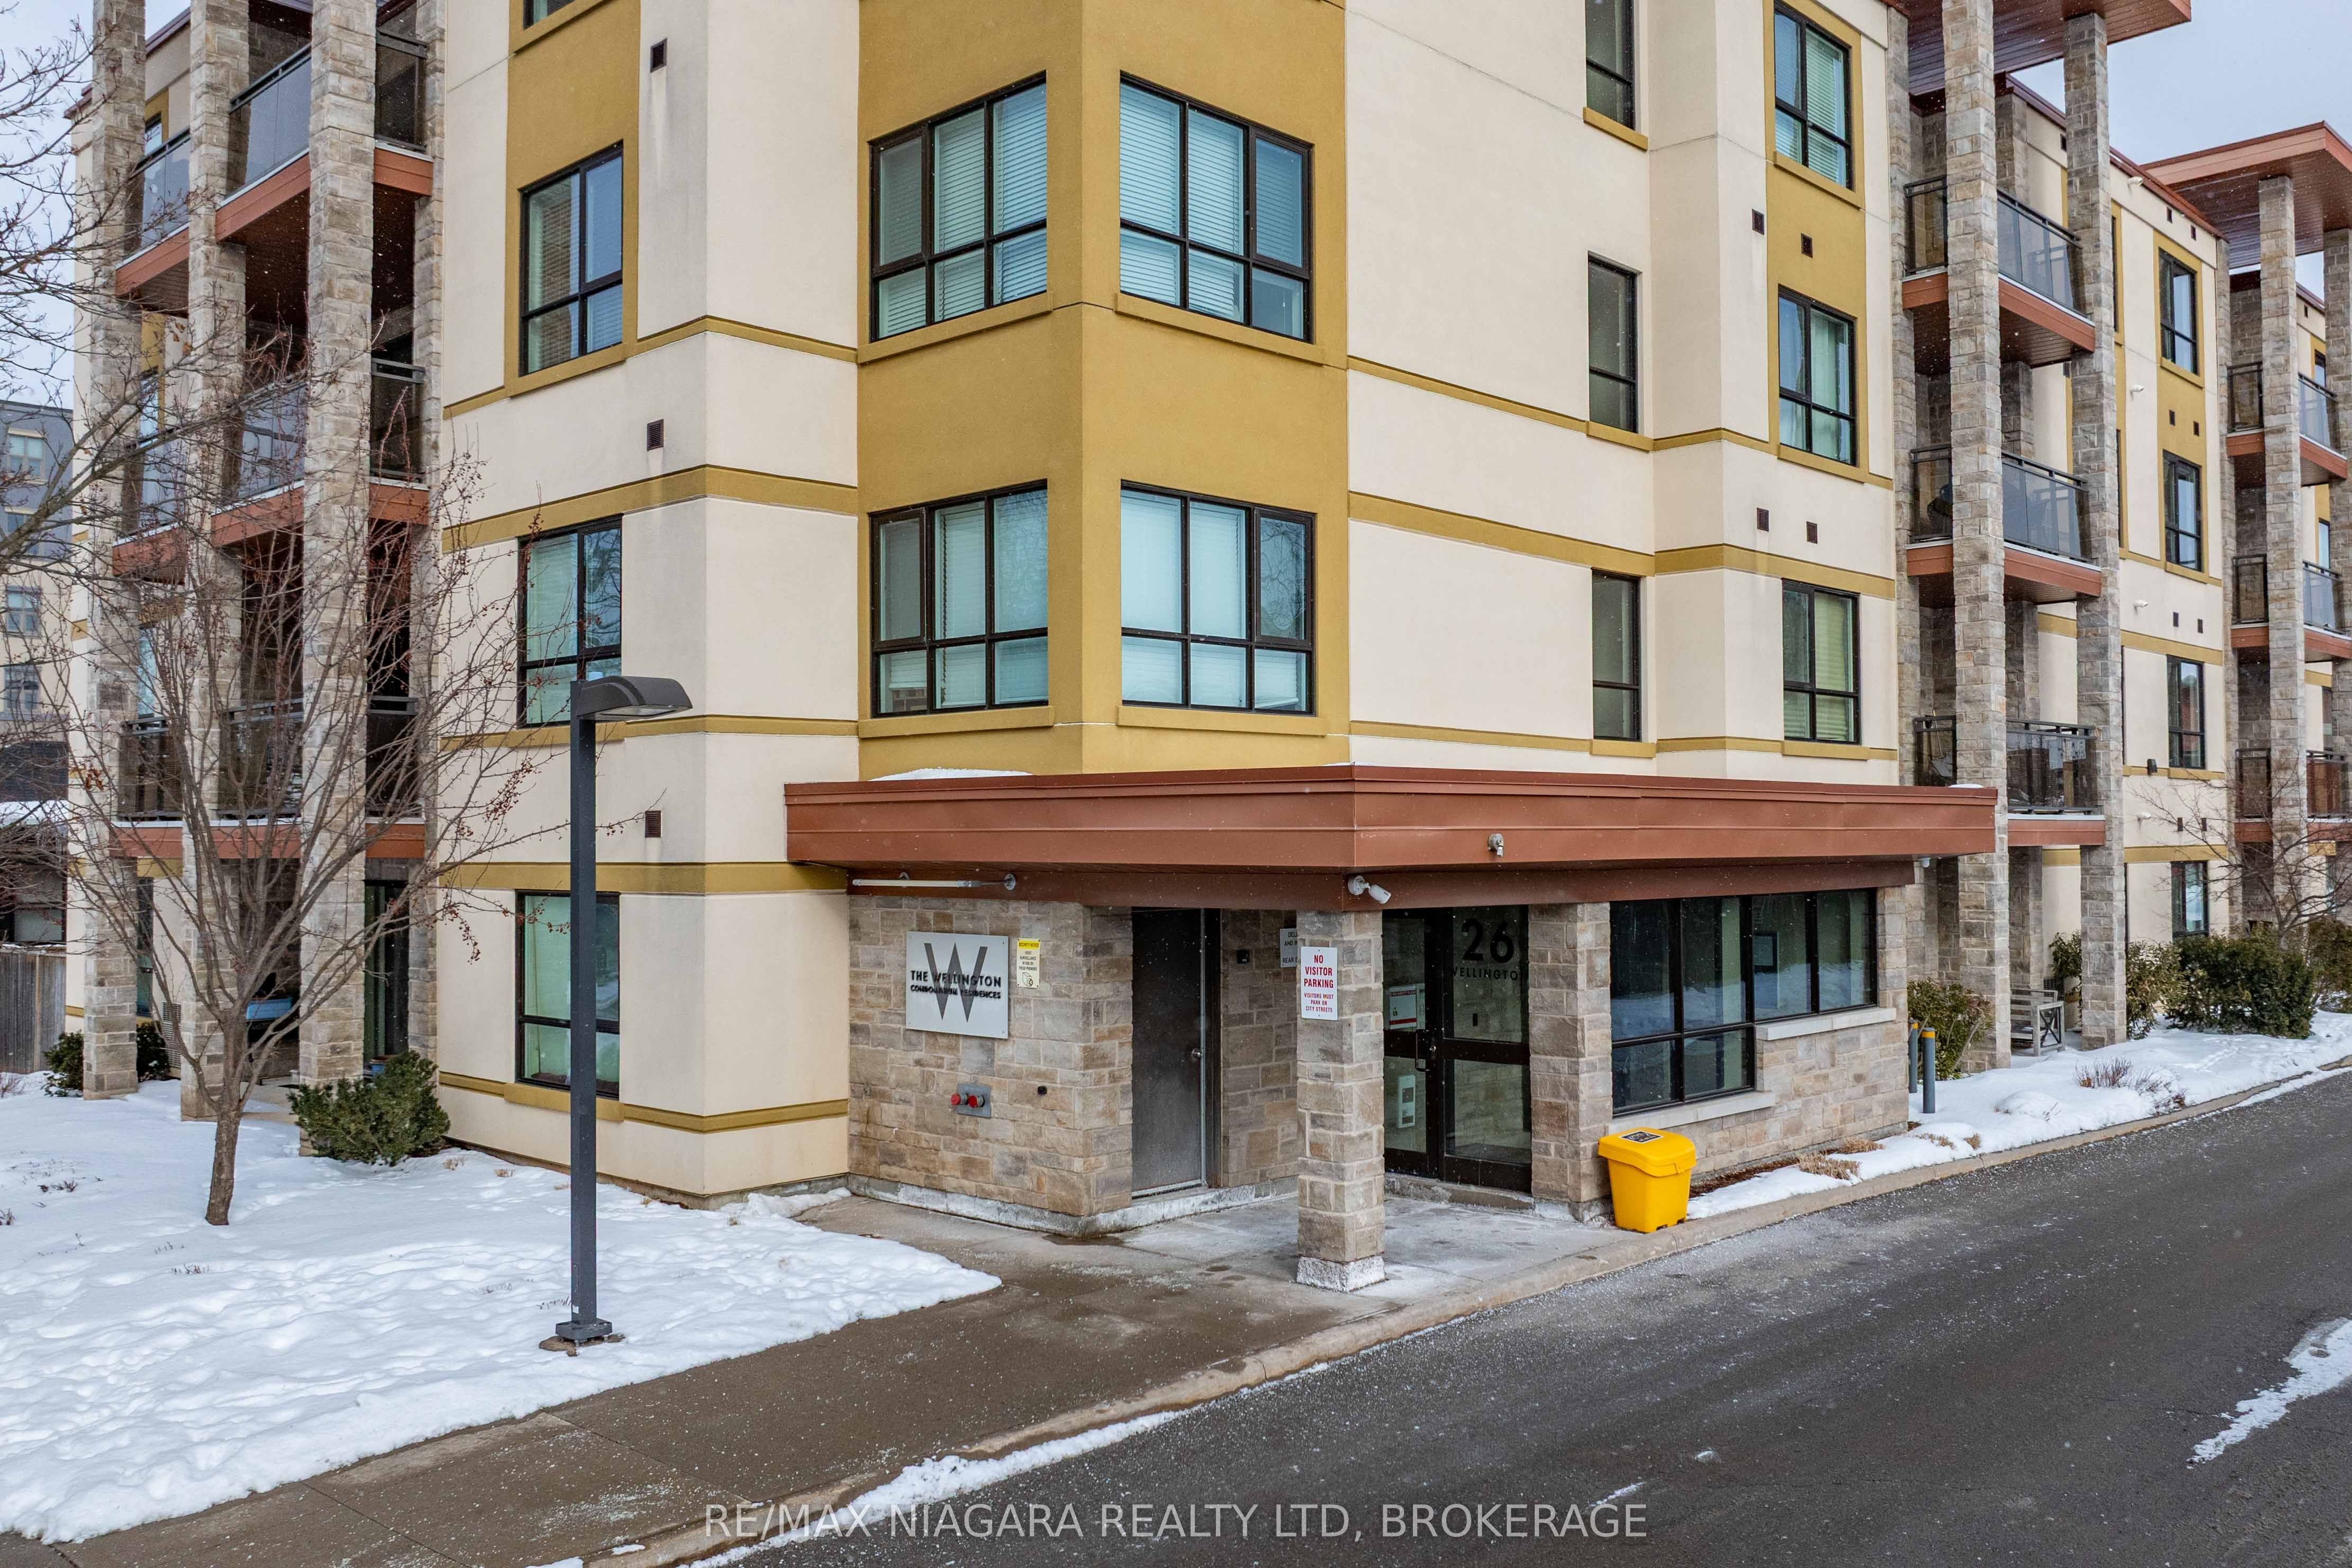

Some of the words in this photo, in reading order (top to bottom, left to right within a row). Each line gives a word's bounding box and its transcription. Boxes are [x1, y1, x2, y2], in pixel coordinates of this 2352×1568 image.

[1462, 917, 1514, 963] 26
[1314, 954, 1323, 963] NO
[1305, 966, 1332, 976] VISITOR
[1449, 967, 1518, 980] WELLINGTO
[911, 970, 928, 981] THE
[933, 972, 1001, 988] WELLINGTON
[924, 942, 988, 1023] W
[1304, 978, 1333, 988] PARKING
